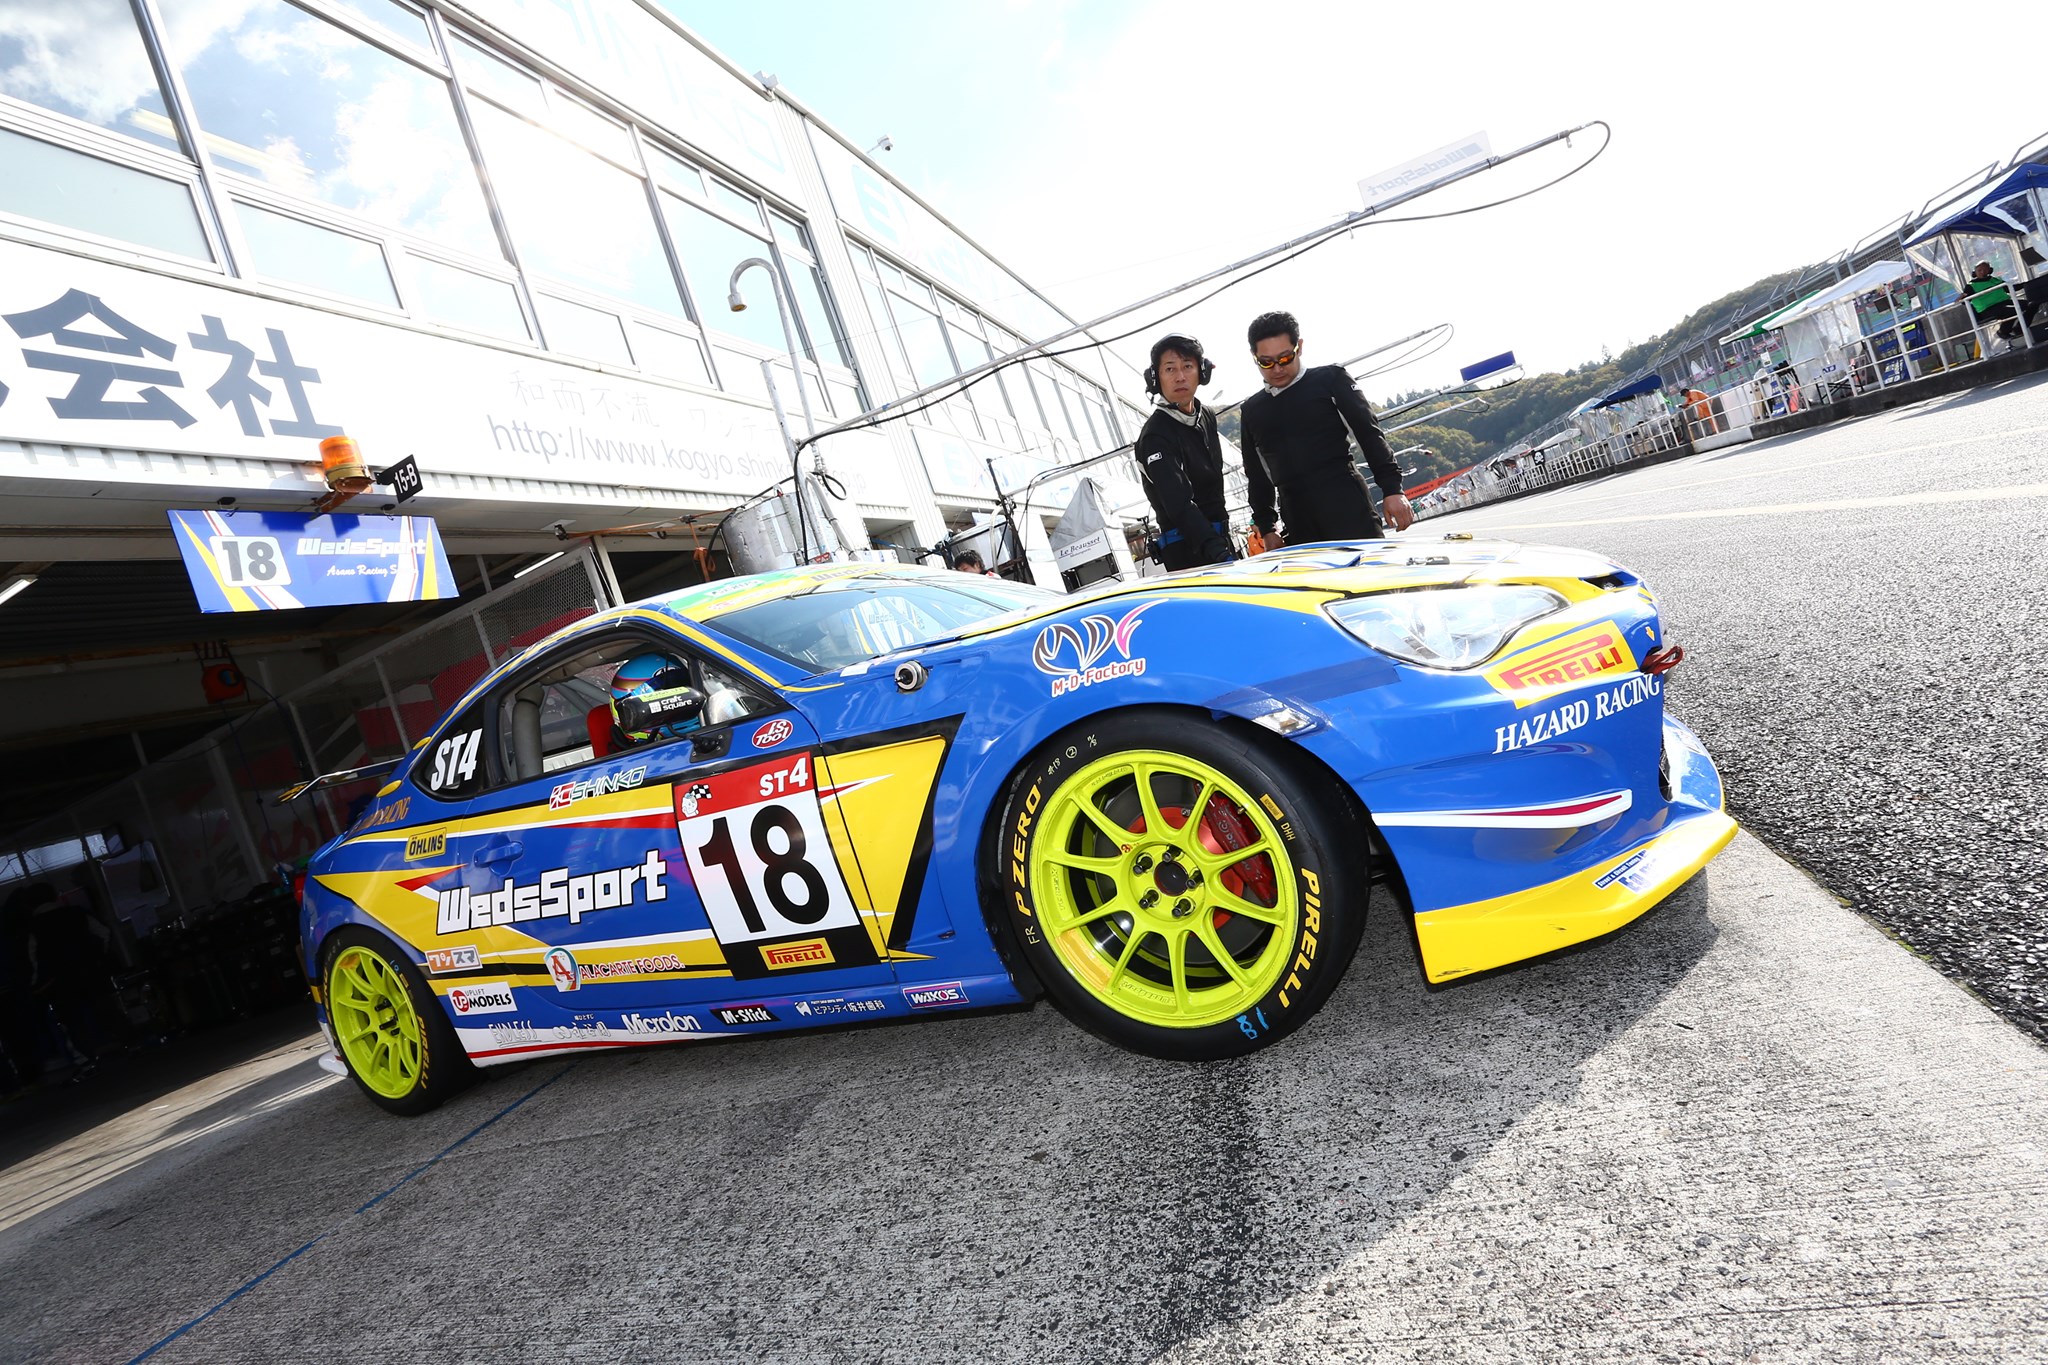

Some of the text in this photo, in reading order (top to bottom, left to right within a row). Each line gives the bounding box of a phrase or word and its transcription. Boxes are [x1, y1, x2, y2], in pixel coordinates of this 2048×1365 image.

[0, 287, 345, 439] 会社
[394, 462, 418, 494] 15-B
[222, 537, 427, 582] 18 WedsSport
[327, 565, 355, 577] Asano
[357, 564, 388, 578] Racing
[1499, 633, 1624, 691] PIRELLI
[660, 695, 682, 706] craft
[662, 699, 692, 711] square
[1493, 674, 1661, 754] HAZARD RACING
[430, 728, 483, 791] ST4
[572, 765, 647, 801] SHINKO
[760, 757, 809, 797] ST4
[409, 836, 443, 857] ÖHLINS
[699, 805, 830, 934] 18
[1012, 784, 1042, 945] FR P ZERO
[436, 849, 666, 936] WedsSport
[1278, 867, 1321, 1008] PIRELLI
[580, 959, 636, 980] ALACARTE
[766, 943, 827, 966] PIRELLI
[466, 988, 485, 998] UPLIFT
[469, 993, 512, 1008] MODELS
[488, 1020, 538, 1044] ENDLESS
[621, 1011, 702, 1035] Microlon
[720, 1008, 771, 1024] M-Stick
